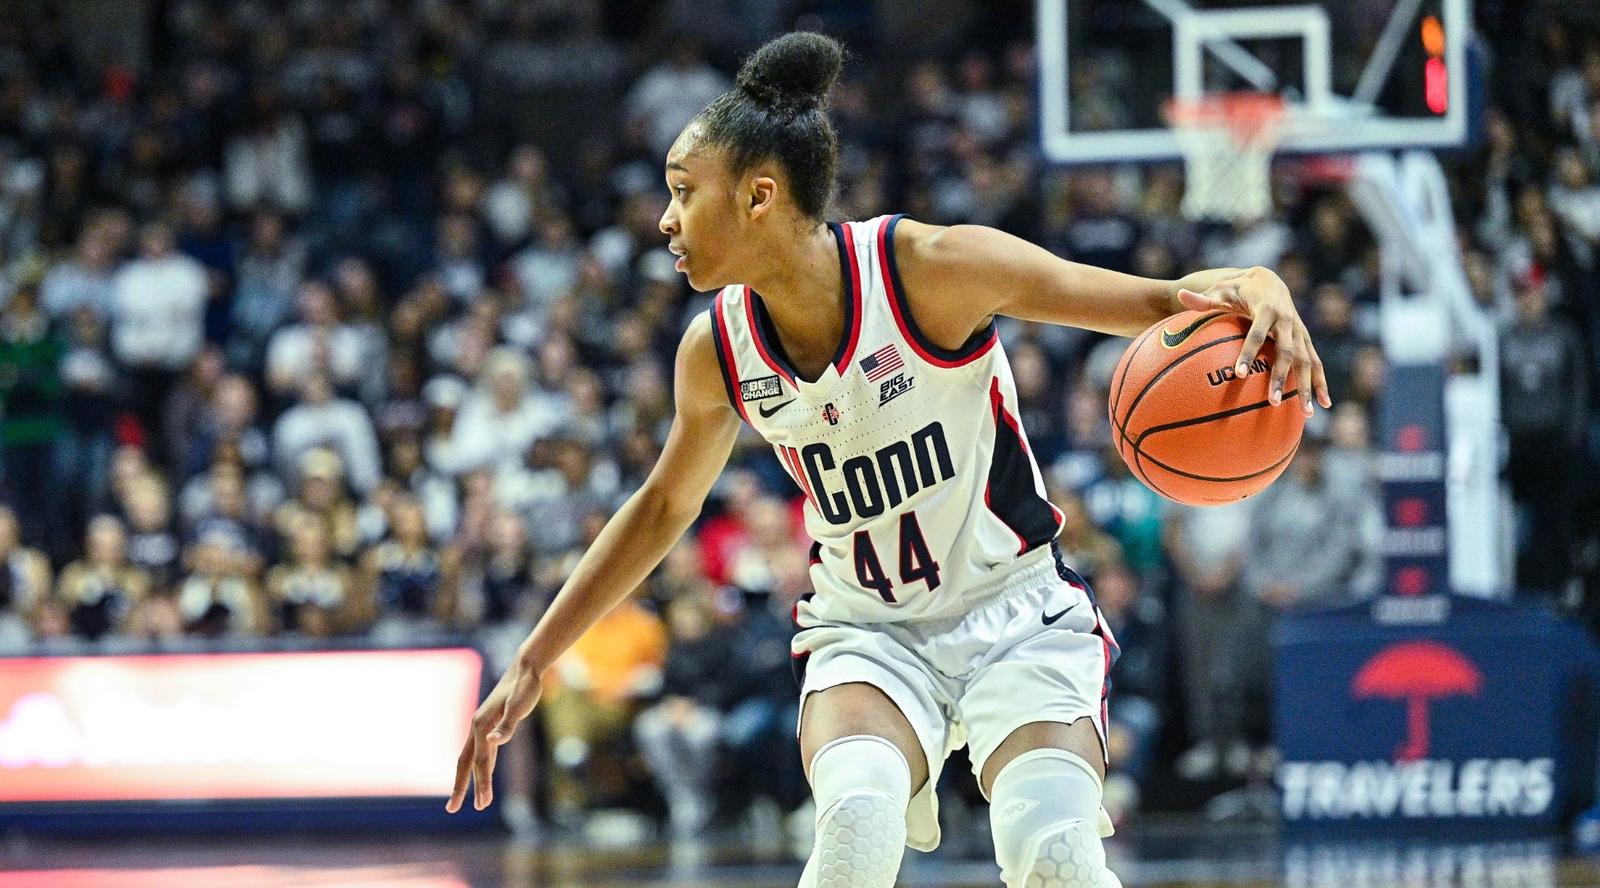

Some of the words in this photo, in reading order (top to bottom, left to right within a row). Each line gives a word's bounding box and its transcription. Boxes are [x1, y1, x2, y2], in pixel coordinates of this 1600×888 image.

[880, 372, 904, 393] BIG
[1206, 359, 1272, 387] UCNN
[743, 388, 780, 401] CHANGE
[880, 376, 915, 402] EAST
[852, 510, 942, 603] 44
[1278, 758, 1555, 819] TRAVELERS
